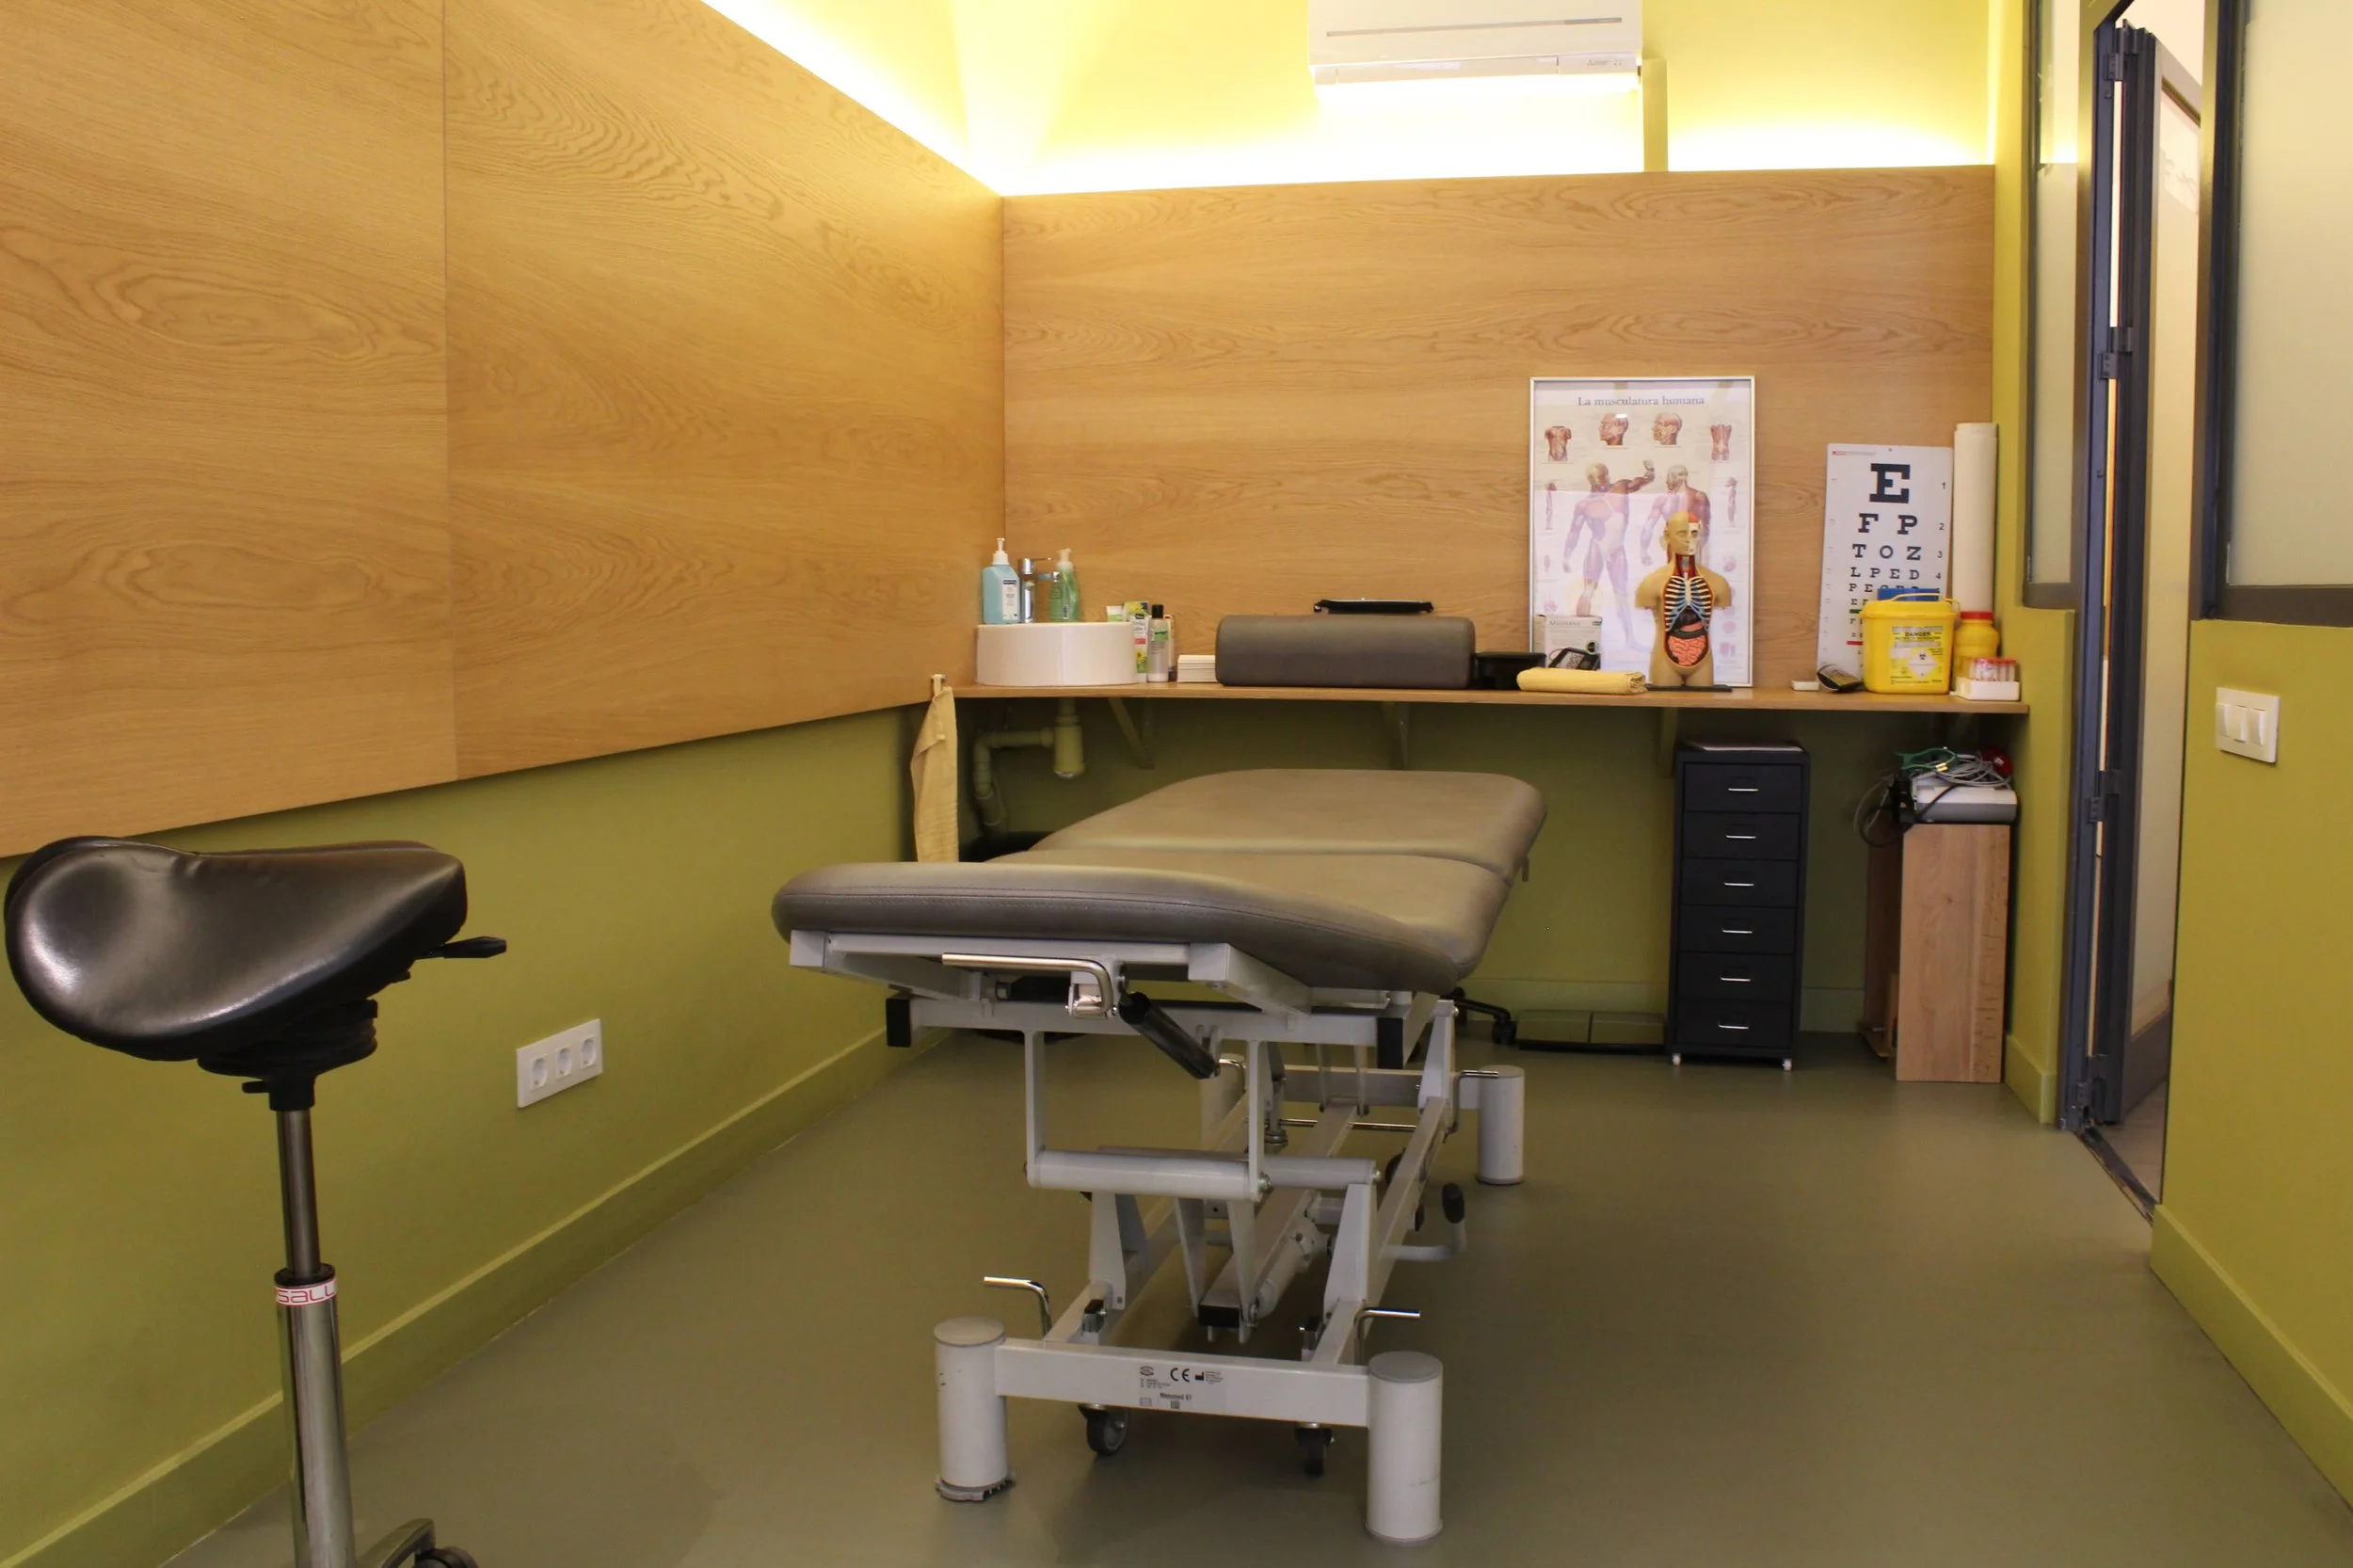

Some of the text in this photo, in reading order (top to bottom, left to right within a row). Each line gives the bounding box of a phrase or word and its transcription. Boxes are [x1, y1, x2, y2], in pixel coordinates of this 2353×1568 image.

[1577, 395, 1705, 407] La musculatura humana
[1869, 463, 1911, 504] E
[1858, 513, 1945, 535] F P 2
[1852, 544, 1866, 558] T
[1880, 545, 1894, 559] O
[1906, 546, 1921, 561] Z
[1850, 567, 1861, 577] L
[1869, 568, 1881, 578] P
[1889, 568, 1900, 579] E
[1909, 569, 1920, 580] D
[1849, 583, 1858, 592] P
[1864, 584, 1873, 593] E
